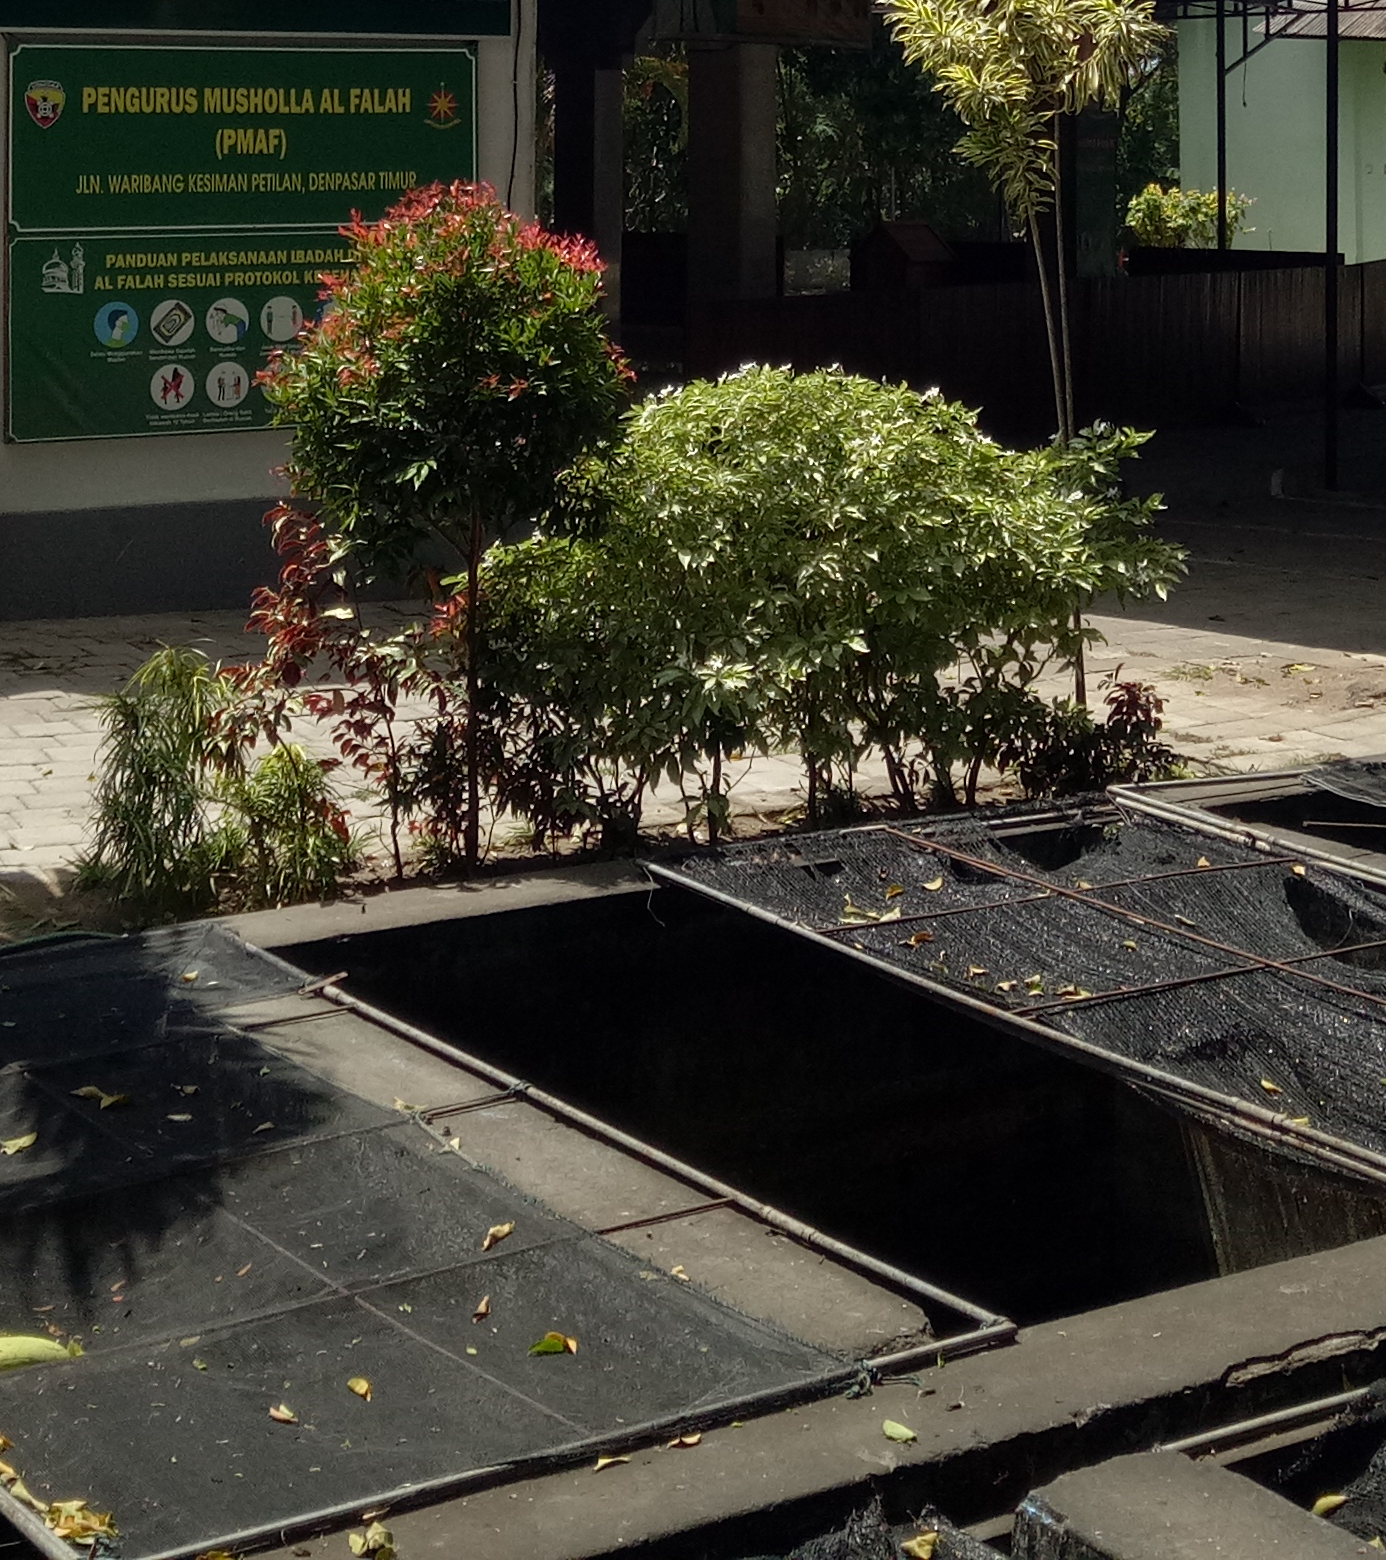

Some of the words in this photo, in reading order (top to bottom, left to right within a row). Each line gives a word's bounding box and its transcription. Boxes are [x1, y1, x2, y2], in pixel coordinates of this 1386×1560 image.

[82, 86, 199, 114] PENGURUS
[203, 87, 315, 115] MUSHOLLA
[319, 88, 345, 114] AL
[349, 88, 412, 113] FALAH
[215, 128, 288, 161] (PMAF)
[75, 174, 105, 195] JLN.
[108, 173, 186, 195] WARIBANG
[188, 172, 248, 193] KESIMAN
[251, 172, 306, 195] PETILAN,
[308, 171, 376, 191] DENPASAR
[378, 170, 417, 190] TIMUR
[104, 252, 178, 269] PANDUAN
[180, 249, 287, 267] PELAKSANAAN
[94, 275, 114, 290] AL
[116, 273, 165, 290] FALAH
[167, 271, 221, 288] SESUAI
[224, 269, 301, 287] PROTOKOL
